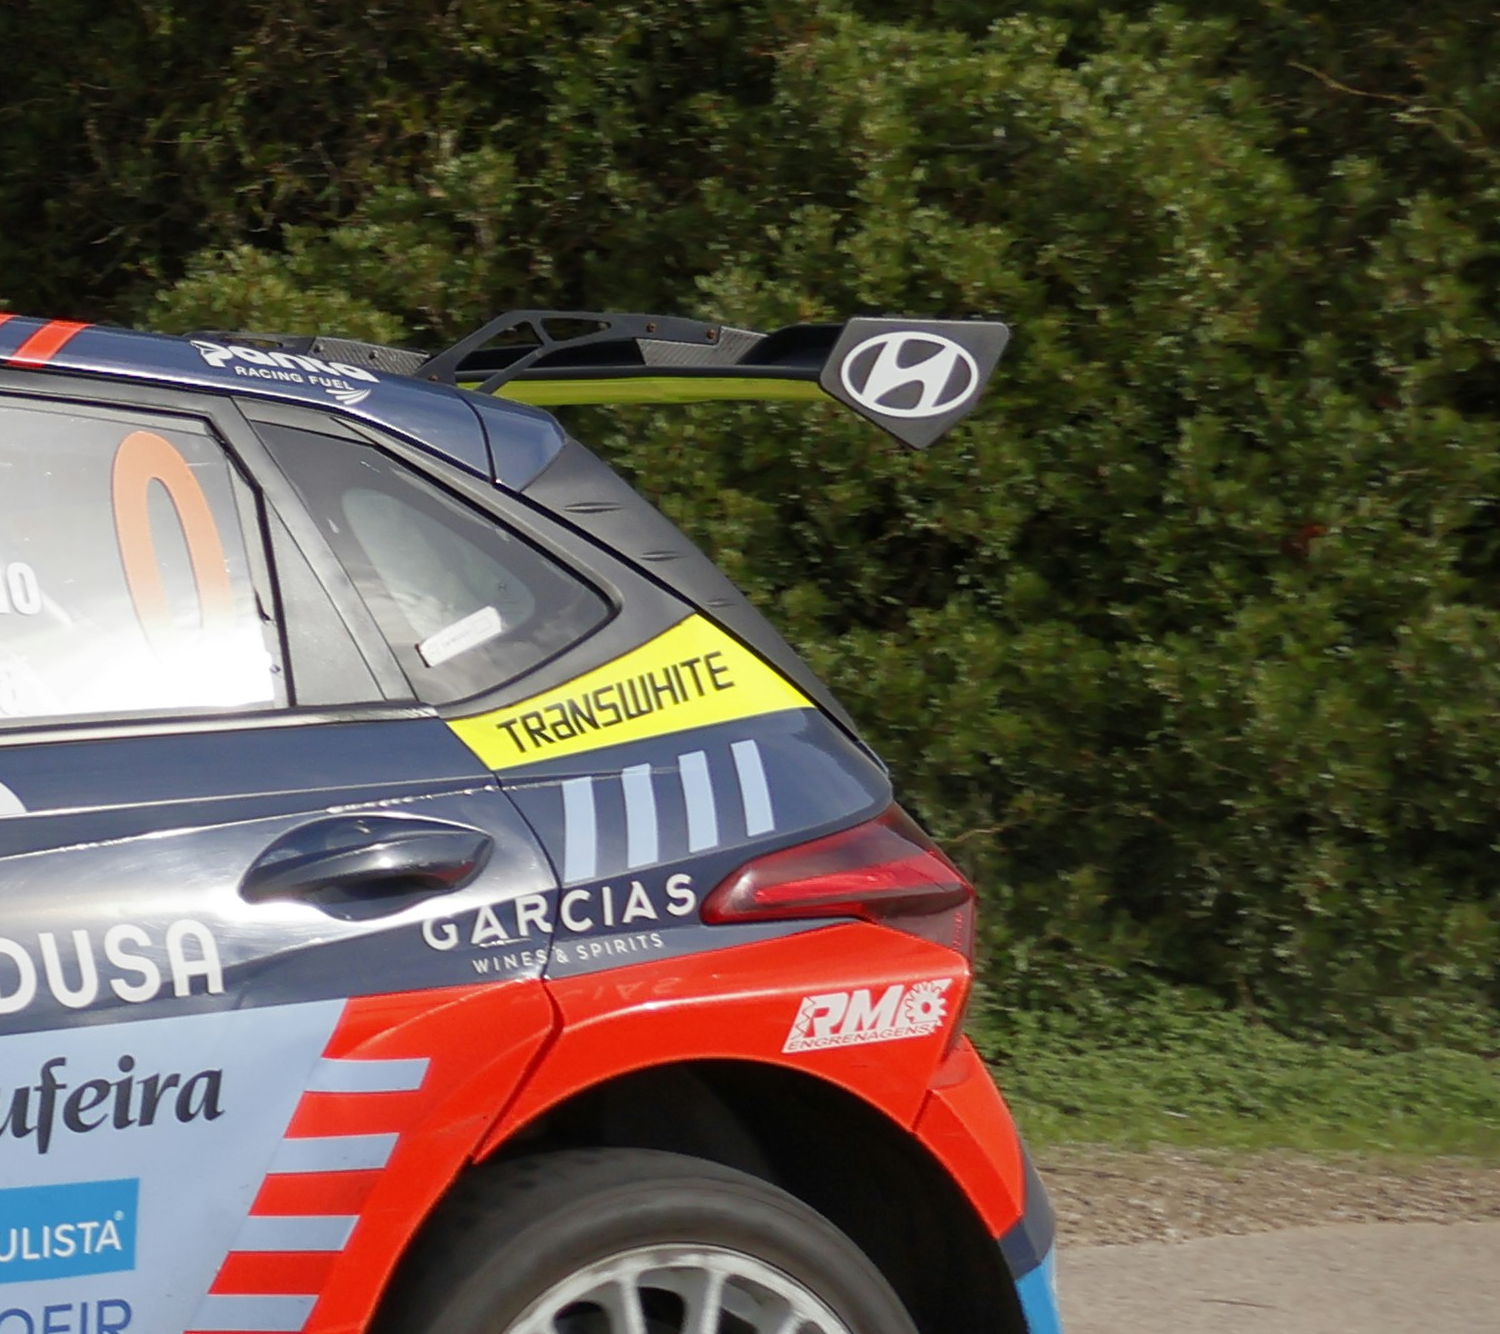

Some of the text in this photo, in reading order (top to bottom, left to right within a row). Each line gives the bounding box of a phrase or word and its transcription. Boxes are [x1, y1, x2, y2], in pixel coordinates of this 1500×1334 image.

[235, 366, 354, 390] RACING FUEL
[422, 874, 697, 951] GARCIAS
[472, 933, 665, 974] WINES & SPIRITS
[787, 1023, 932, 1052] ENGRENAGENS
